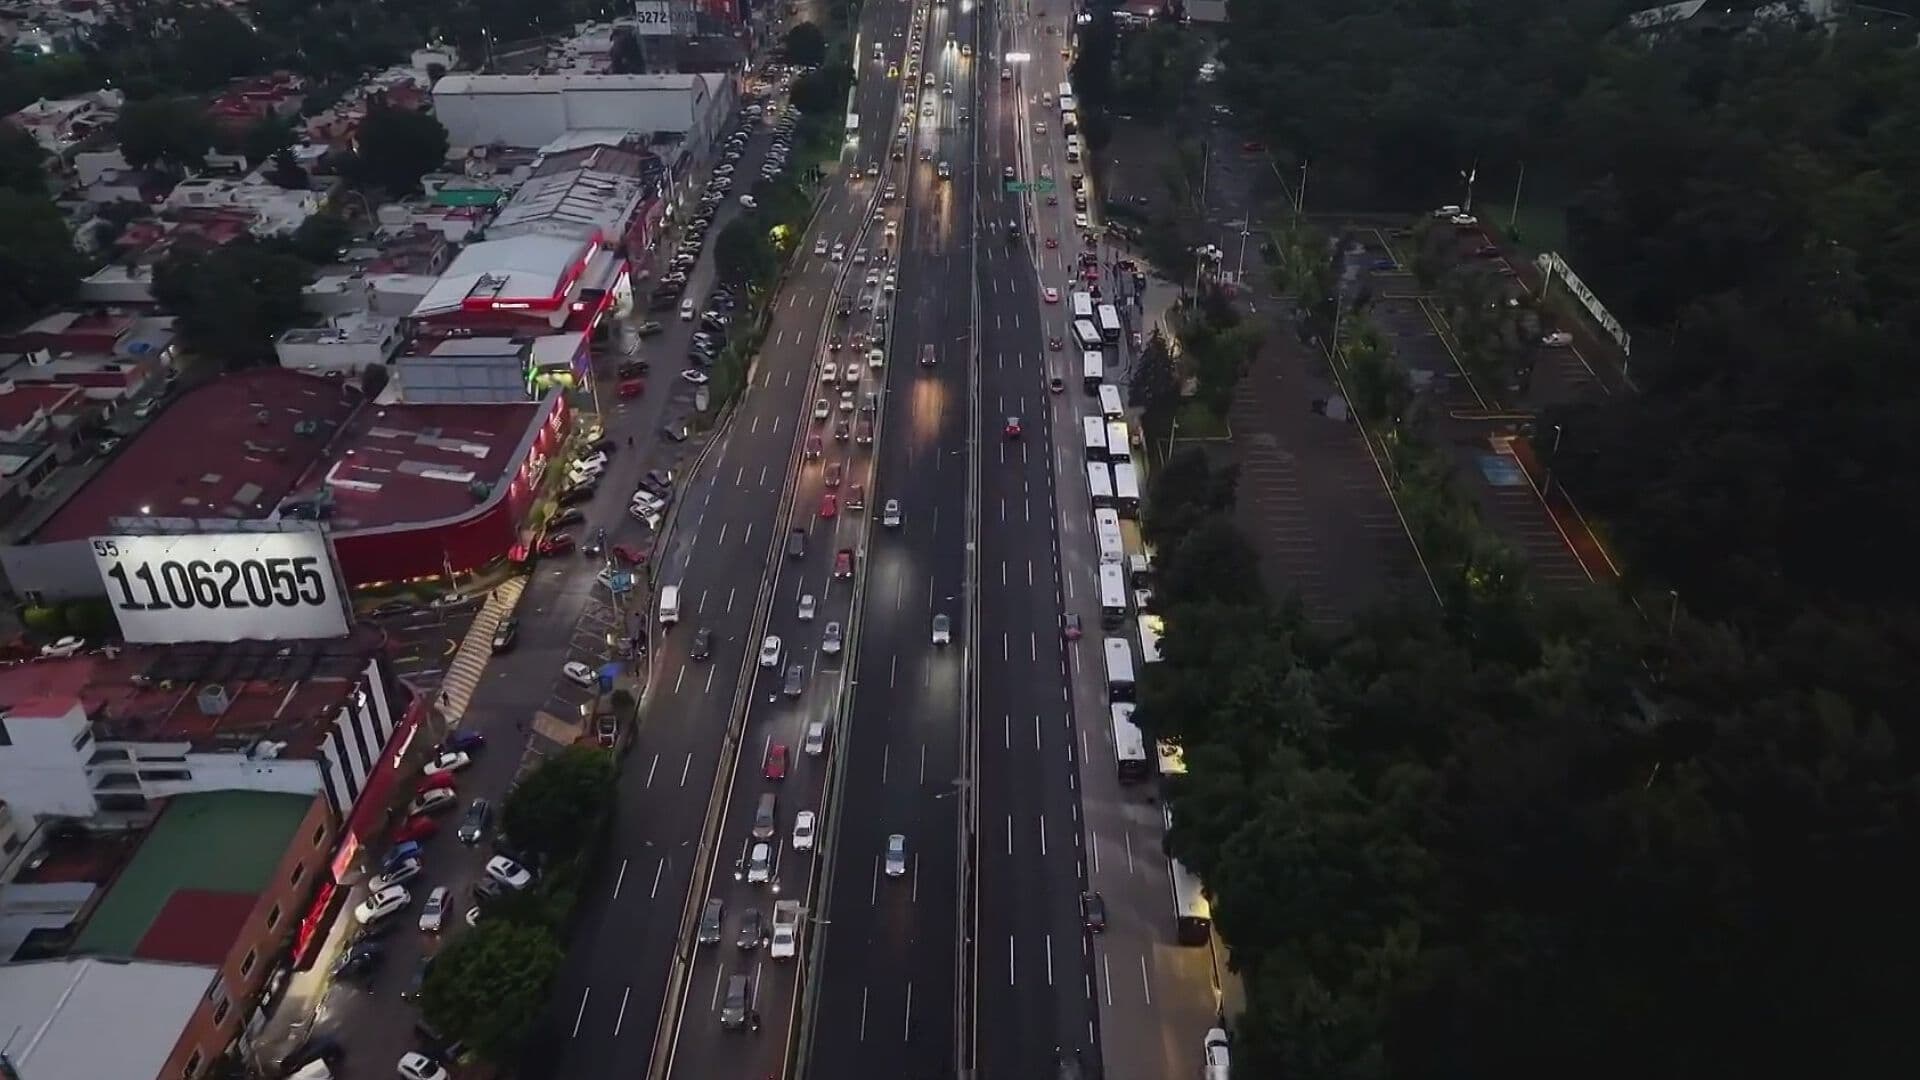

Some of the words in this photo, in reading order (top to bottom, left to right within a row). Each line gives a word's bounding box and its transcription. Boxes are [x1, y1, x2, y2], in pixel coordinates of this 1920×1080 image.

[638, 11, 667, 23] 5272
[94, 540, 119, 557] 55
[108, 557, 326, 610] 11062055
